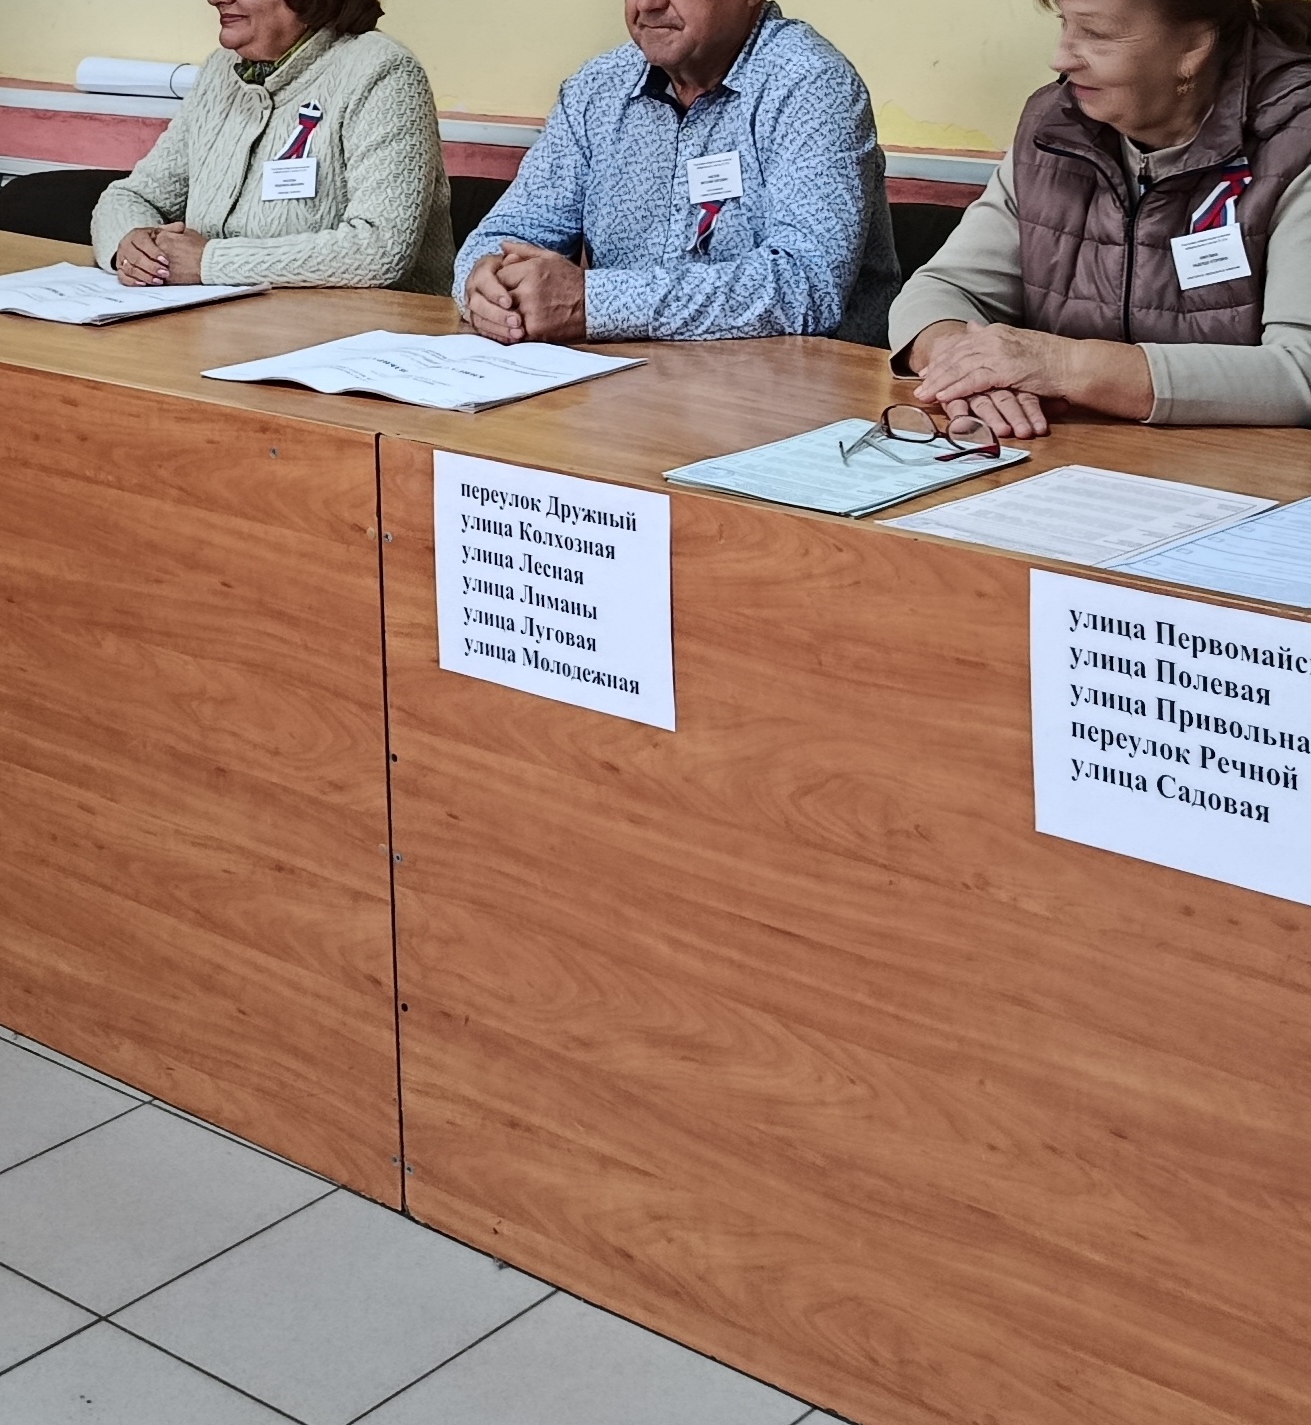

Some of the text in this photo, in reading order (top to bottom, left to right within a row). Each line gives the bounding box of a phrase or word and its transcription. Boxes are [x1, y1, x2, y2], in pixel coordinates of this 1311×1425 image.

[461, 483, 637, 532] переулок Дружный
[461, 513, 615, 560] улица Колхозная
[462, 544, 584, 585] улица Лесная
[462, 575, 598, 620] улица Лиманы
[463, 606, 596, 652] улица Луговая
[1069, 608, 1146, 641] улица
[464, 637, 640, 695] улица Молодежная
[1069, 645, 1271, 706] улица Полевая
[1070, 683, 1146, 717] улица
[1071, 720, 1298, 791] переулок Речной
[1071, 758, 1270, 823] улица Садовая
